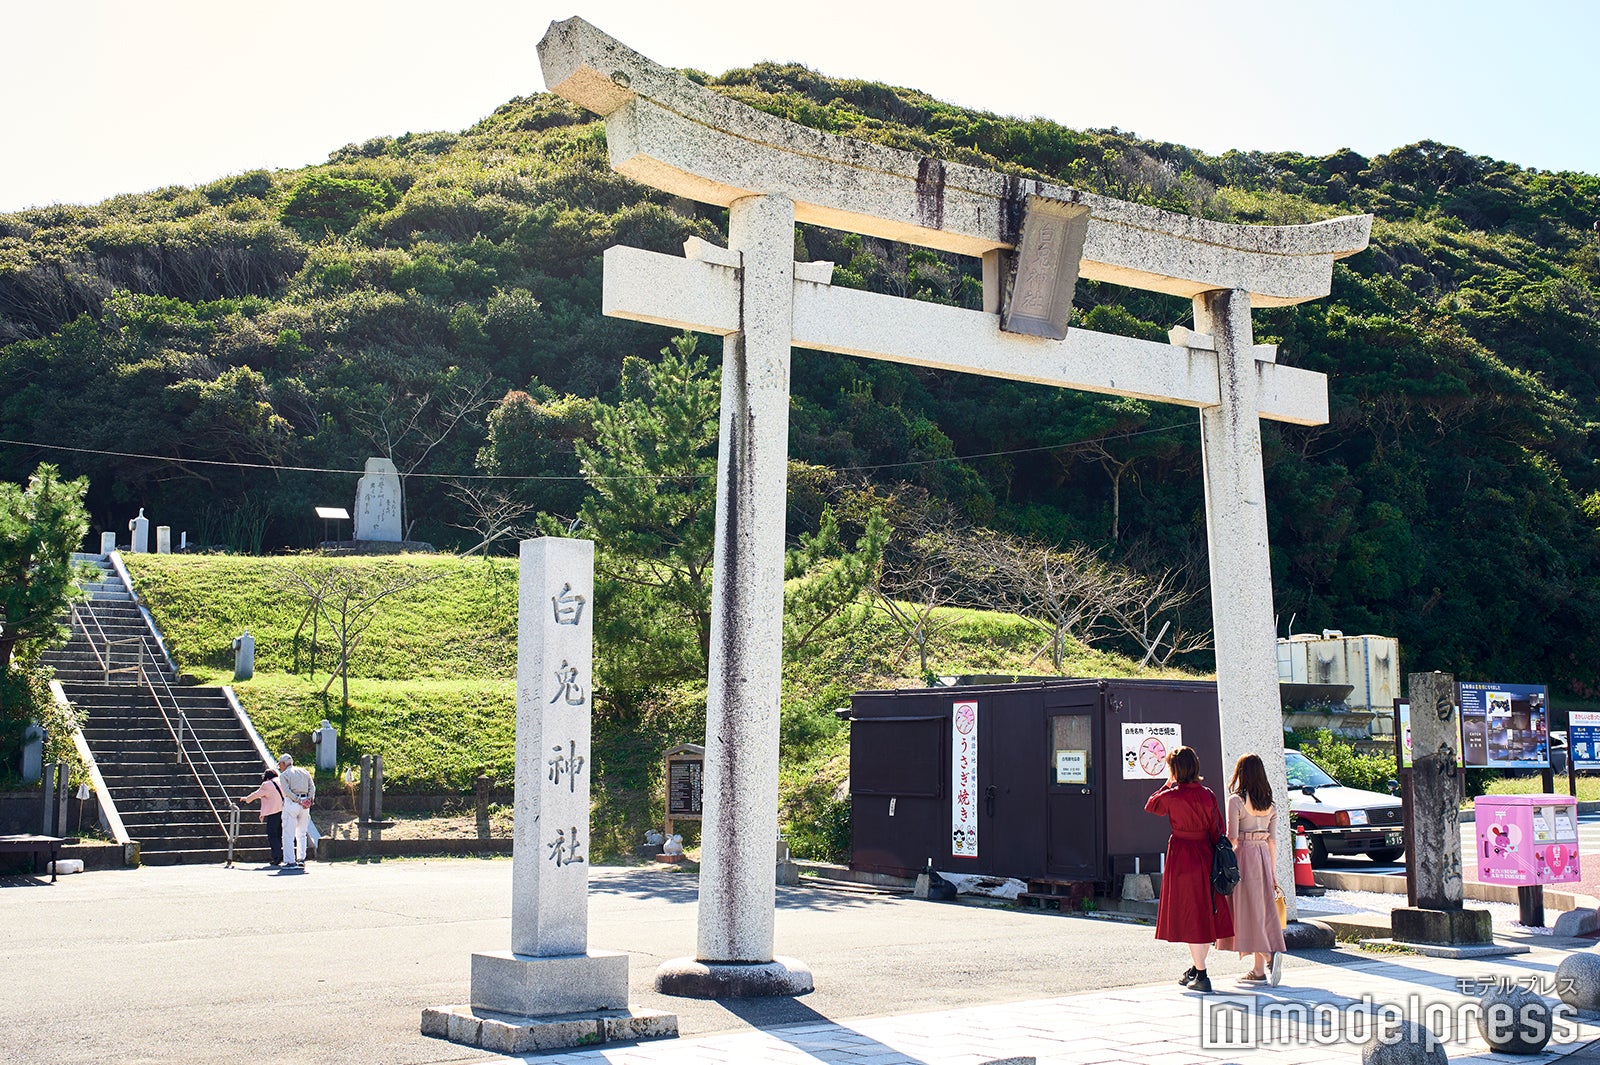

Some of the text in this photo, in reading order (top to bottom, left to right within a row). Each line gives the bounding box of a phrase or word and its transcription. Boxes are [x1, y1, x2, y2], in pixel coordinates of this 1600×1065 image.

[957, 737, 970, 823] うさぎ焼き
